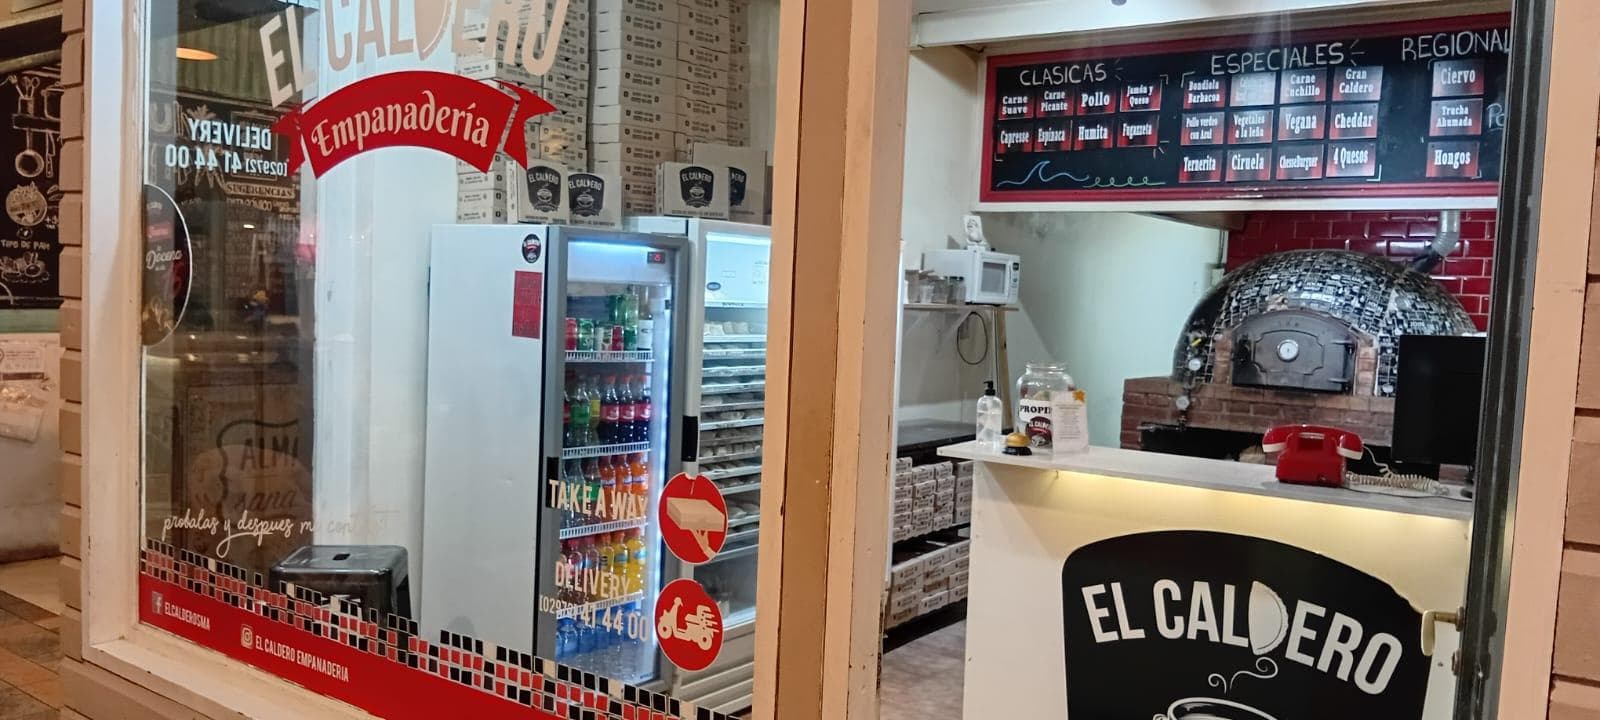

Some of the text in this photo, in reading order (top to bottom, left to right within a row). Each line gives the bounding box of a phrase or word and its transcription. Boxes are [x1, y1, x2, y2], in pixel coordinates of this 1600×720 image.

[259, 4, 319, 108] EL
[1211, 42, 1345, 76] ESPECIALES
[1019, 63, 1107, 86] CLASICAS
[1290, 74, 1316, 85] Carne
[1345, 68, 1367, 80] Gran
[1440, 67, 1476, 85] Ciervo
[1188, 79, 1220, 91] Bondiola
[1339, 81, 1374, 94] Caldero
[1002, 95, 1028, 105] Carne
[1044, 90, 1066, 100] Carne
[1081, 91, 1110, 108] Pollo
[1129, 96, 1149, 107] Queso
[1187, 91, 1220, 104] Barbacoa
[1002, 105, 1028, 115] Suave
[1040, 101, 1068, 112] Picante
[1441, 105, 1469, 116] Trucha
[310, 90, 490, 158] Empanadería
[1285, 113, 1317, 134] Vegana
[1334, 112, 1374, 129] Cheddar
[1436, 116, 1473, 127] Ahumada
[1038, 127, 1065, 146] Espinaca
[1078, 124, 1108, 141] Humita
[1183, 155, 1216, 172] Ternerita
[1231, 153, 1264, 171] Ciruela
[1333, 147, 1369, 169] 4 Quesos
[1434, 149, 1471, 169] Hongos
[528, 173, 536, 183] EL
[549, 479, 649, 521] TAKE A WAY
[237, 509, 294, 547] despues
[555, 561, 632, 601] DELIVERY
[164, 602, 211, 631] ELCALDEROSMA
[602, 607, 624, 635] 44
[627, 611, 650, 642] 00
[1081, 578, 1403, 696] EL CALDERO
[255, 635, 349, 683] EL CALDERO EMPANADERIA
